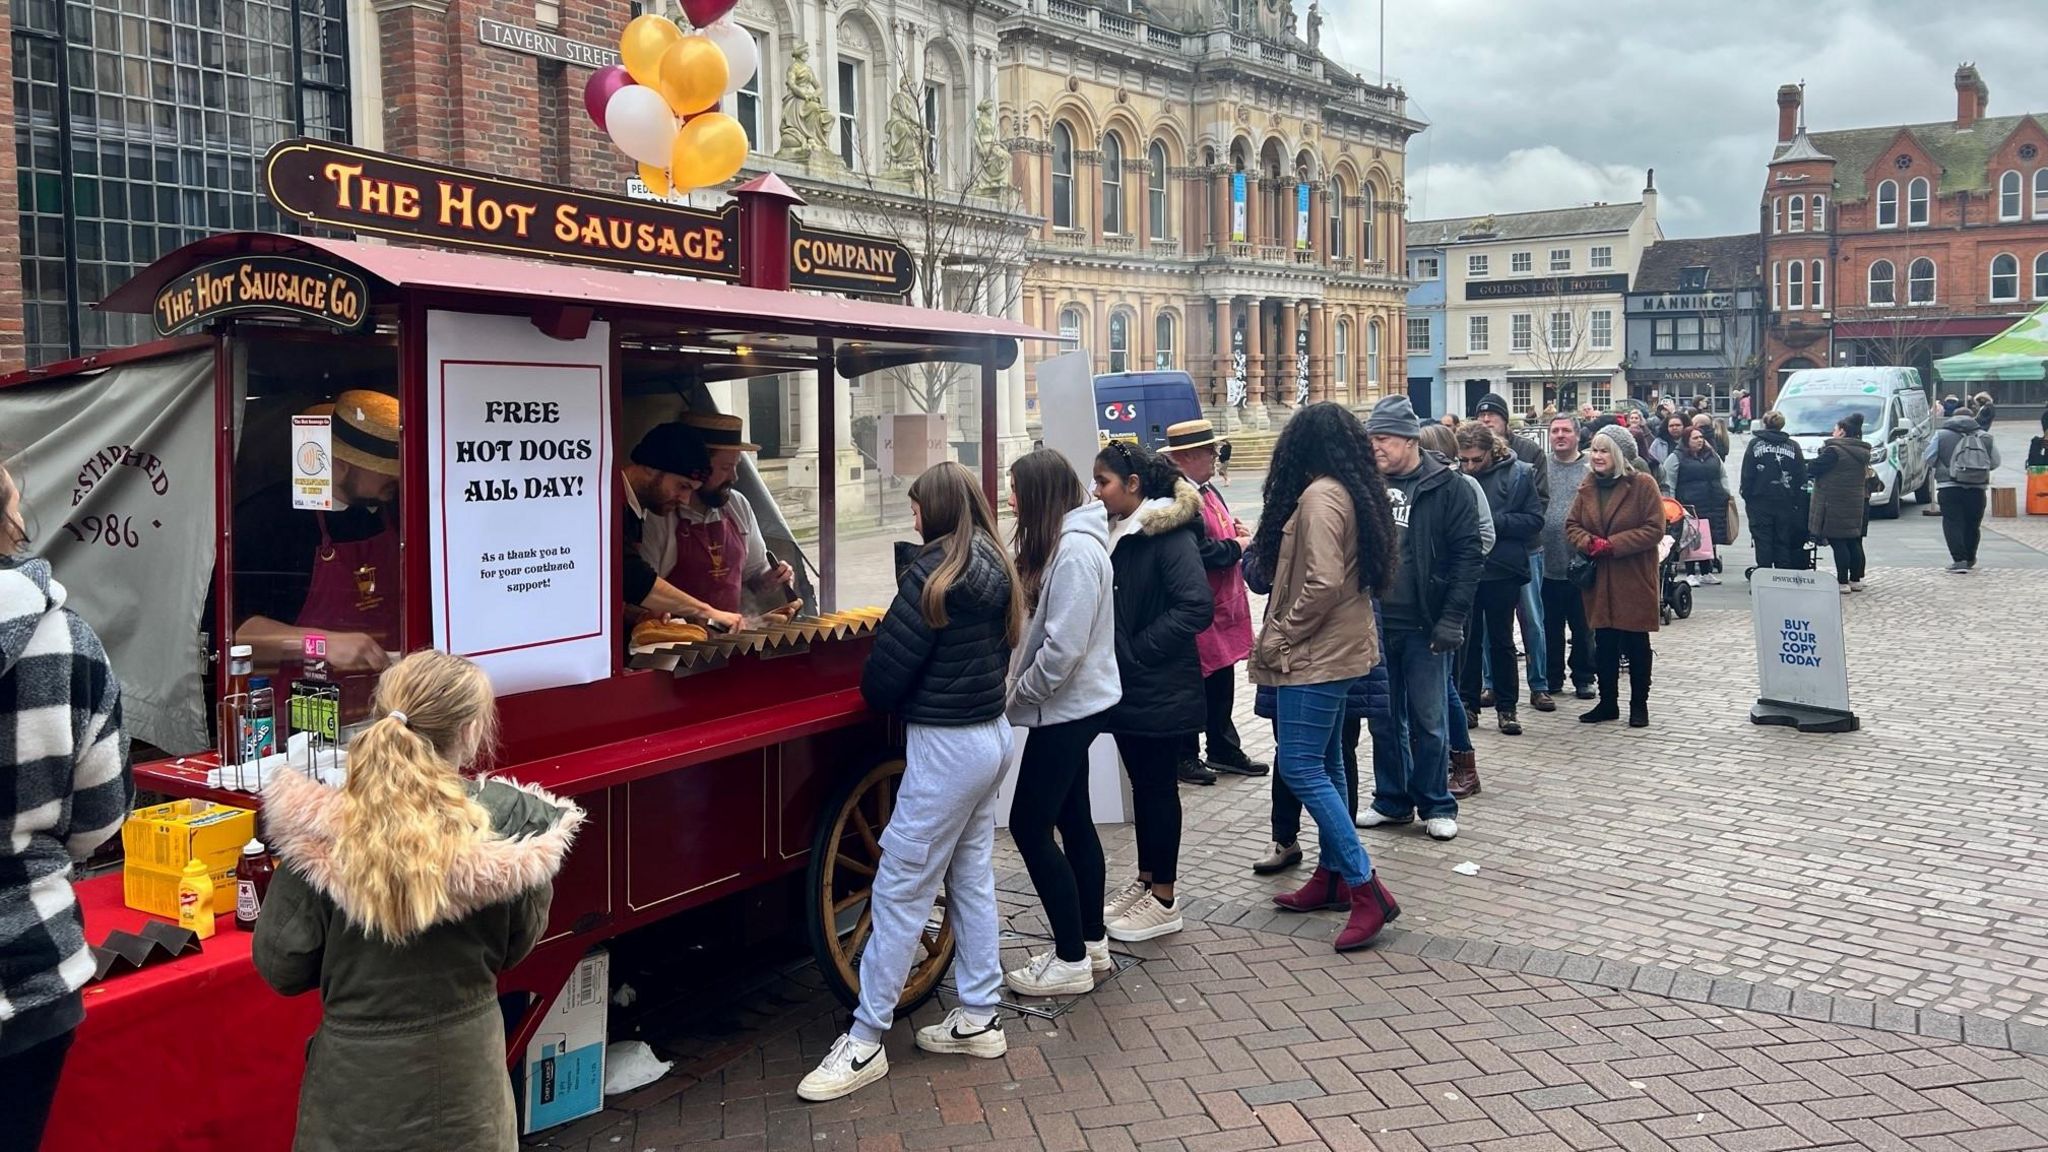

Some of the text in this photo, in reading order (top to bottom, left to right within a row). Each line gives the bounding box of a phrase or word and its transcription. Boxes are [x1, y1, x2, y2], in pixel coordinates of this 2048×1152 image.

[491, 23, 618, 66] TAVERN STREET
[324, 162, 897, 274] THE HOT SAUSAGE COMPANY
[159, 287, 195, 327] THE
[196, 272, 235, 311] HOT
[239, 264, 326, 309] SAUSAGE
[1479, 283, 1528, 295] GOLDEN
[1569, 278, 1613, 291] HOTEL
[1664, 371, 1712, 380] MANNINGS
[485, 400, 560, 424] FREE
[456, 438, 592, 463] HOT DOGS
[464, 475, 584, 502] ALL DAY!
[62, 513, 138, 548] 1986
[481, 545, 571, 562] As a thank you to
[480, 560, 575, 579] for your continued
[506, 577, 551, 593] support!
[1784, 619, 1810, 631] BUY
[1780, 630, 1817, 644] YOUR
[1782, 642, 1817, 655] COPY
[1779, 653, 1822, 667] TODAY
